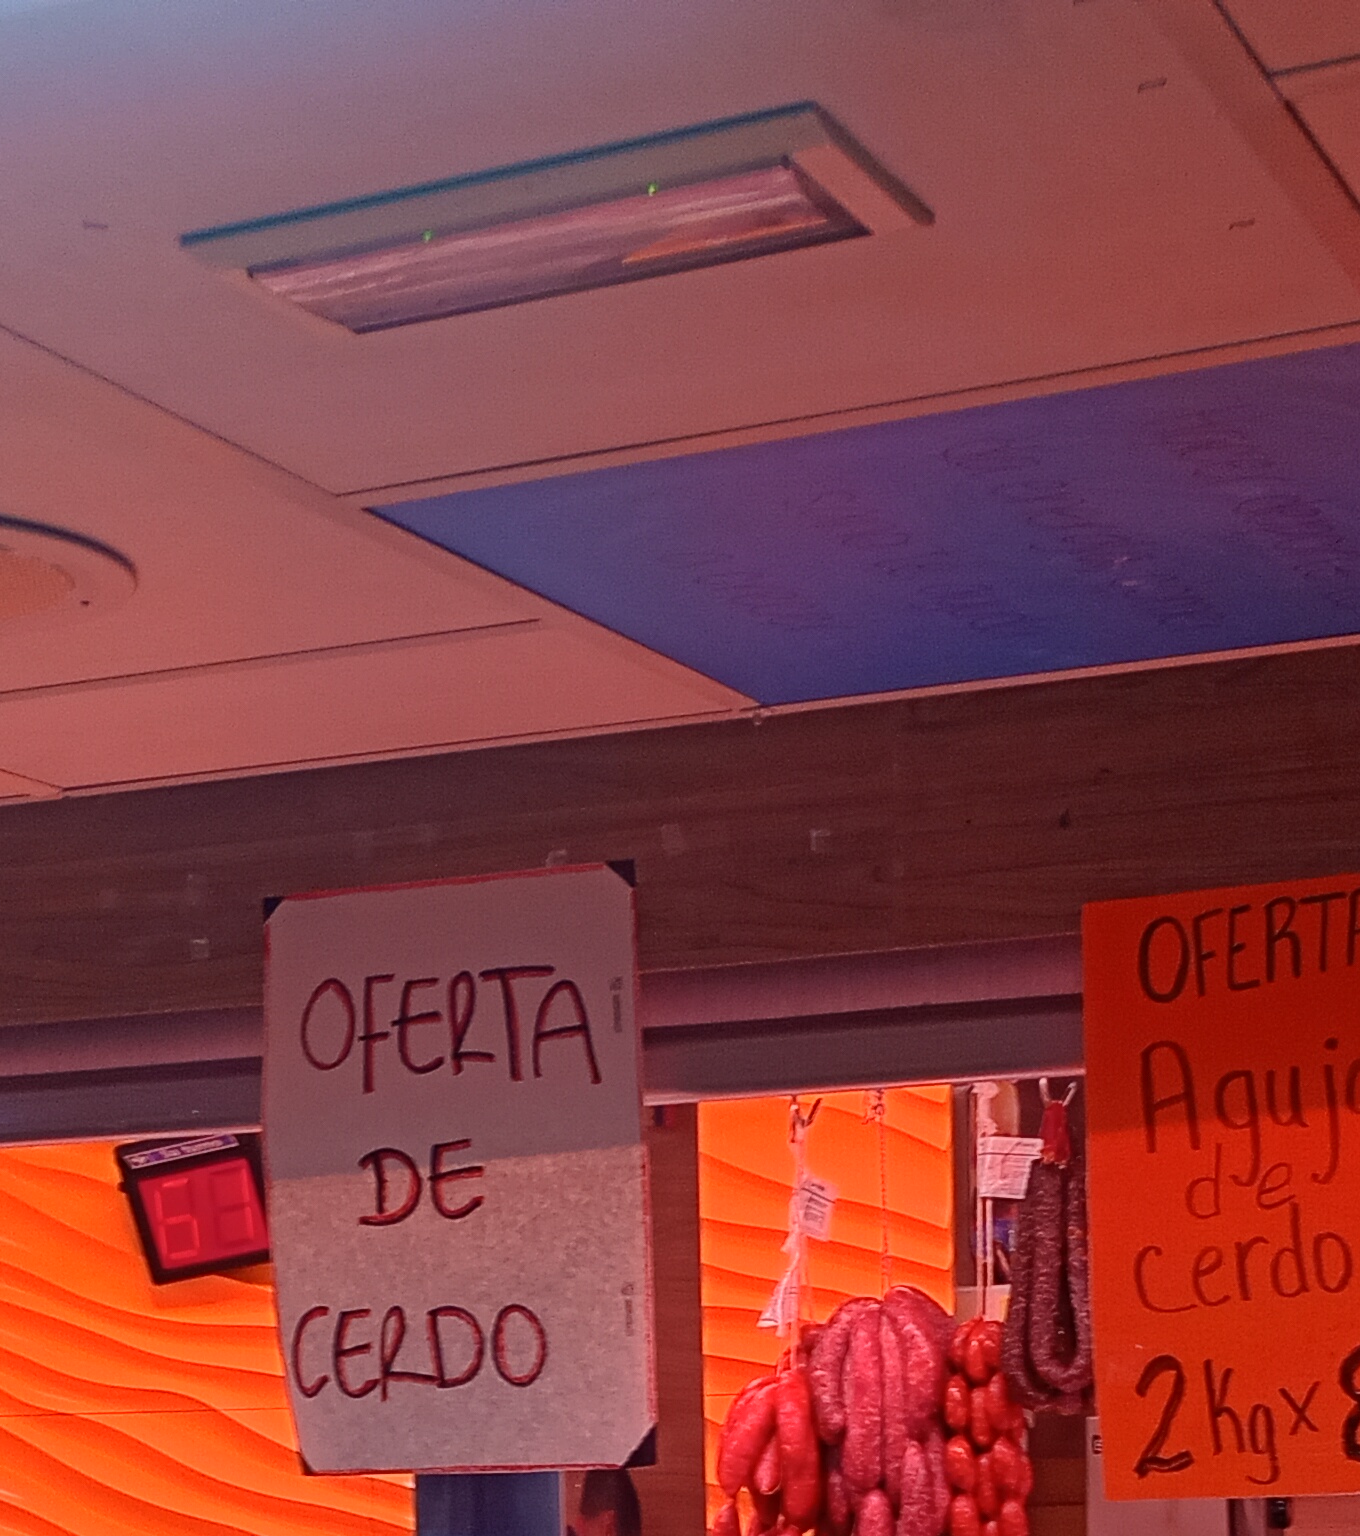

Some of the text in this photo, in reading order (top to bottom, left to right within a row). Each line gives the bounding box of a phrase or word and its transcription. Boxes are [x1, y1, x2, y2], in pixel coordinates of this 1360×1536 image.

[300, 964, 603, 1094] OFERTA
[358, 1137, 485, 1226] DE
[1185, 1142, 1296, 1220] de
[292, 1303, 548, 1401] CERDO
